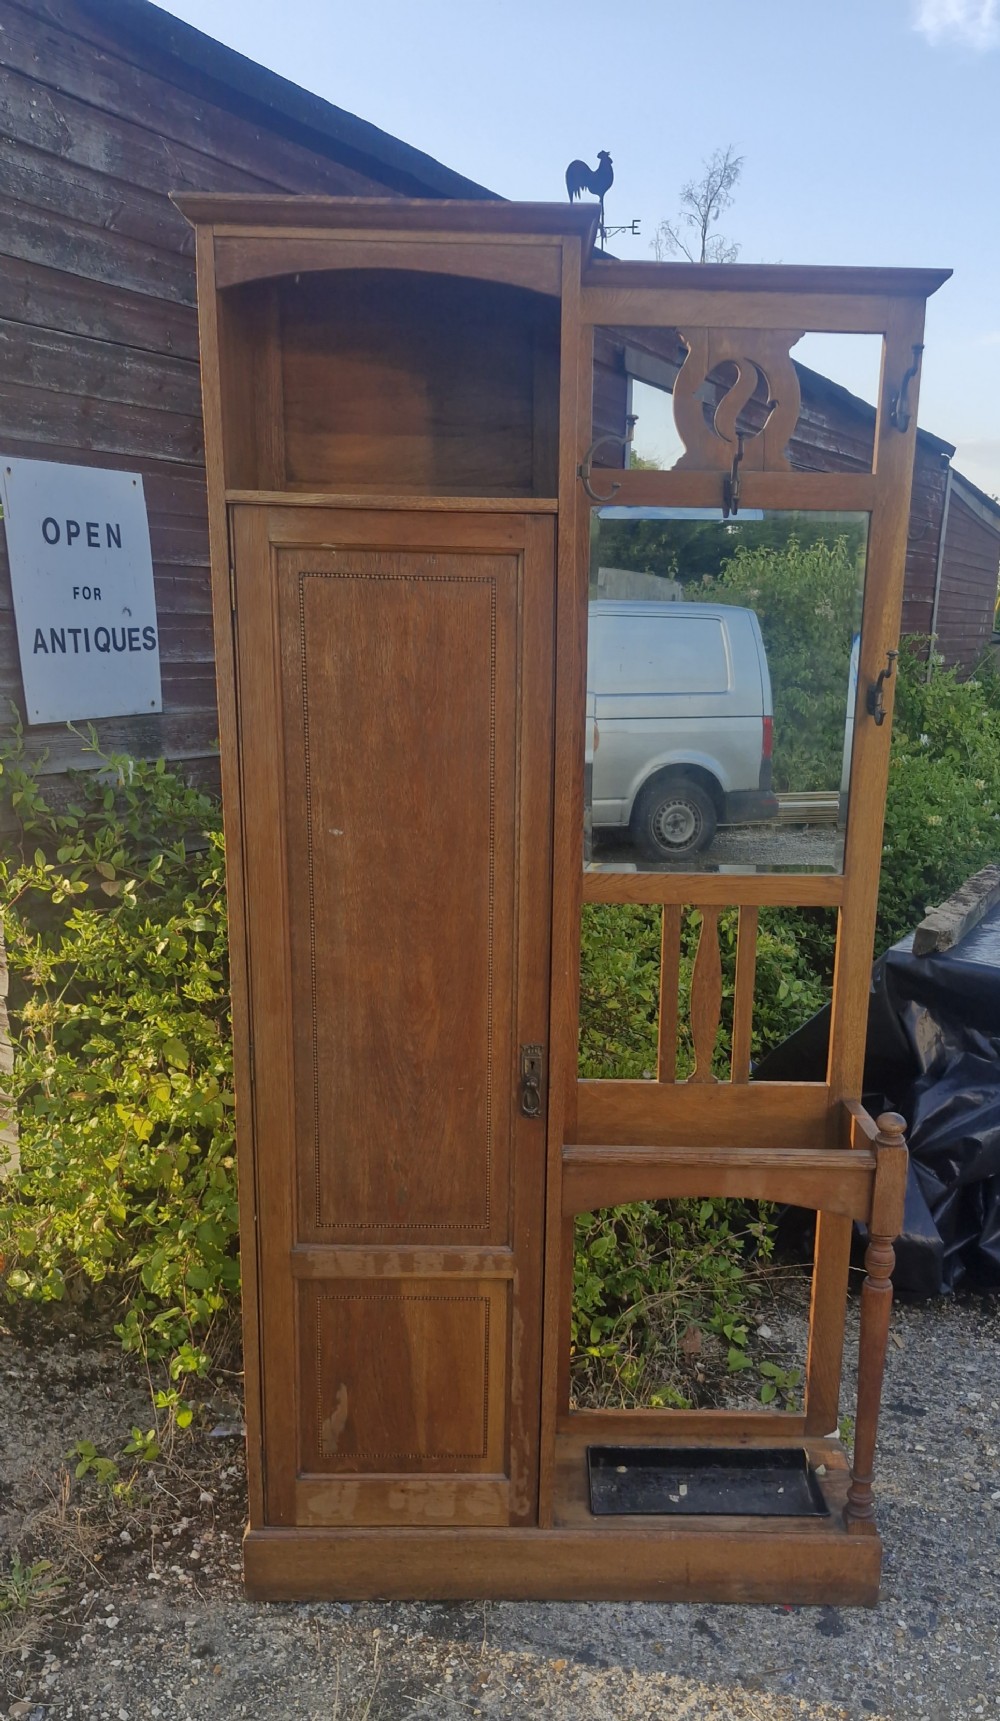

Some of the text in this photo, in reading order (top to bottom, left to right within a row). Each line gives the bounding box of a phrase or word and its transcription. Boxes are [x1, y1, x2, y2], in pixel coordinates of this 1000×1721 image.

[632, 220, 641, 234] E
[42, 517, 122, 548] OPEN
[73, 586, 102, 600] FOR
[33, 626, 156, 654] ANTIQUES
